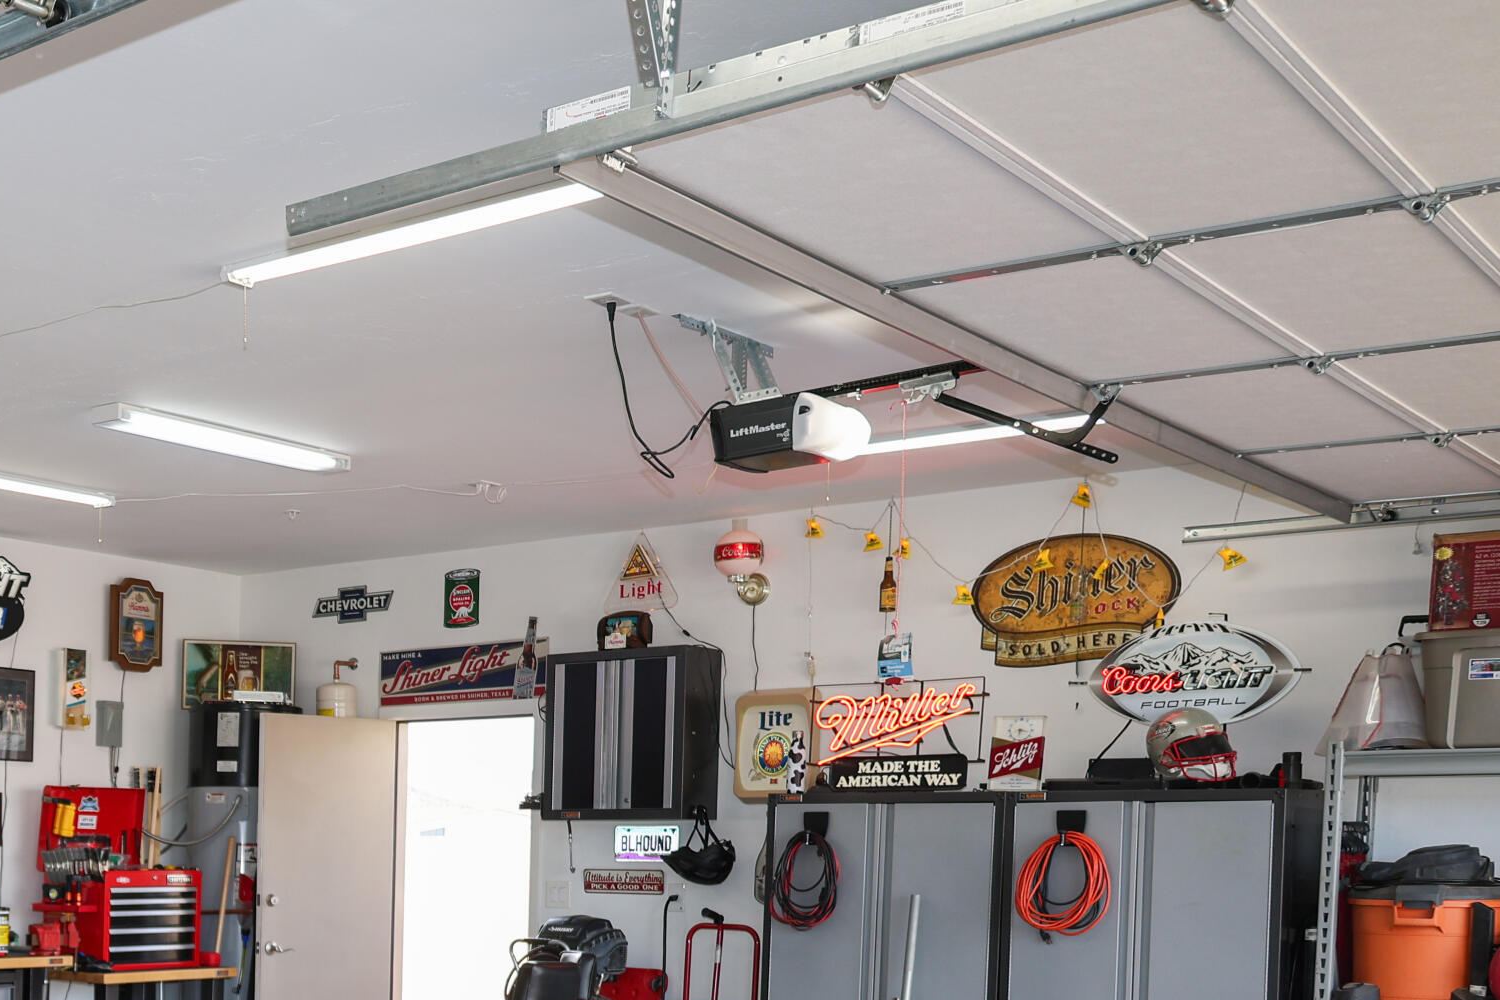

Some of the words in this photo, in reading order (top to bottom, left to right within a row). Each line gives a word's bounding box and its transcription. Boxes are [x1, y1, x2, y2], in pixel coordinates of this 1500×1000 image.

[730, 422, 786, 438] LiftMaster
[620, 581, 663, 599] Light
[990, 553, 1156, 623] Shiner
[319, 595, 386, 613] CHEVROLET
[383, 653, 399, 661] MAKE
[1008, 640, 1061, 657] SOLD
[382, 660, 451, 695] Shiner
[450, 644, 510, 686] Light
[1101, 666, 1184, 695] Coors
[1183, 666, 1274, 690] LIGHT
[435, 694, 459, 702] BREWED
[491, 690, 510, 698] TEXAS
[1140, 697, 1247, 709] FOOTBALL
[759, 711, 793, 731] Lite
[815, 683, 975, 751] Miller
[992, 742, 1038, 774] Schlitz
[858, 761, 904, 774] MADE
[906, 760, 941, 773] THE
[836, 774, 925, 788] AMERICAN
[926, 773, 962, 787] WAY
[621, 835, 672, 852] BLHOUND
[585, 871, 615, 882] Attitude
[616, 873, 623, 882] is
[624, 871, 663, 884] Everything
[642, 883, 659, 891] ONE
